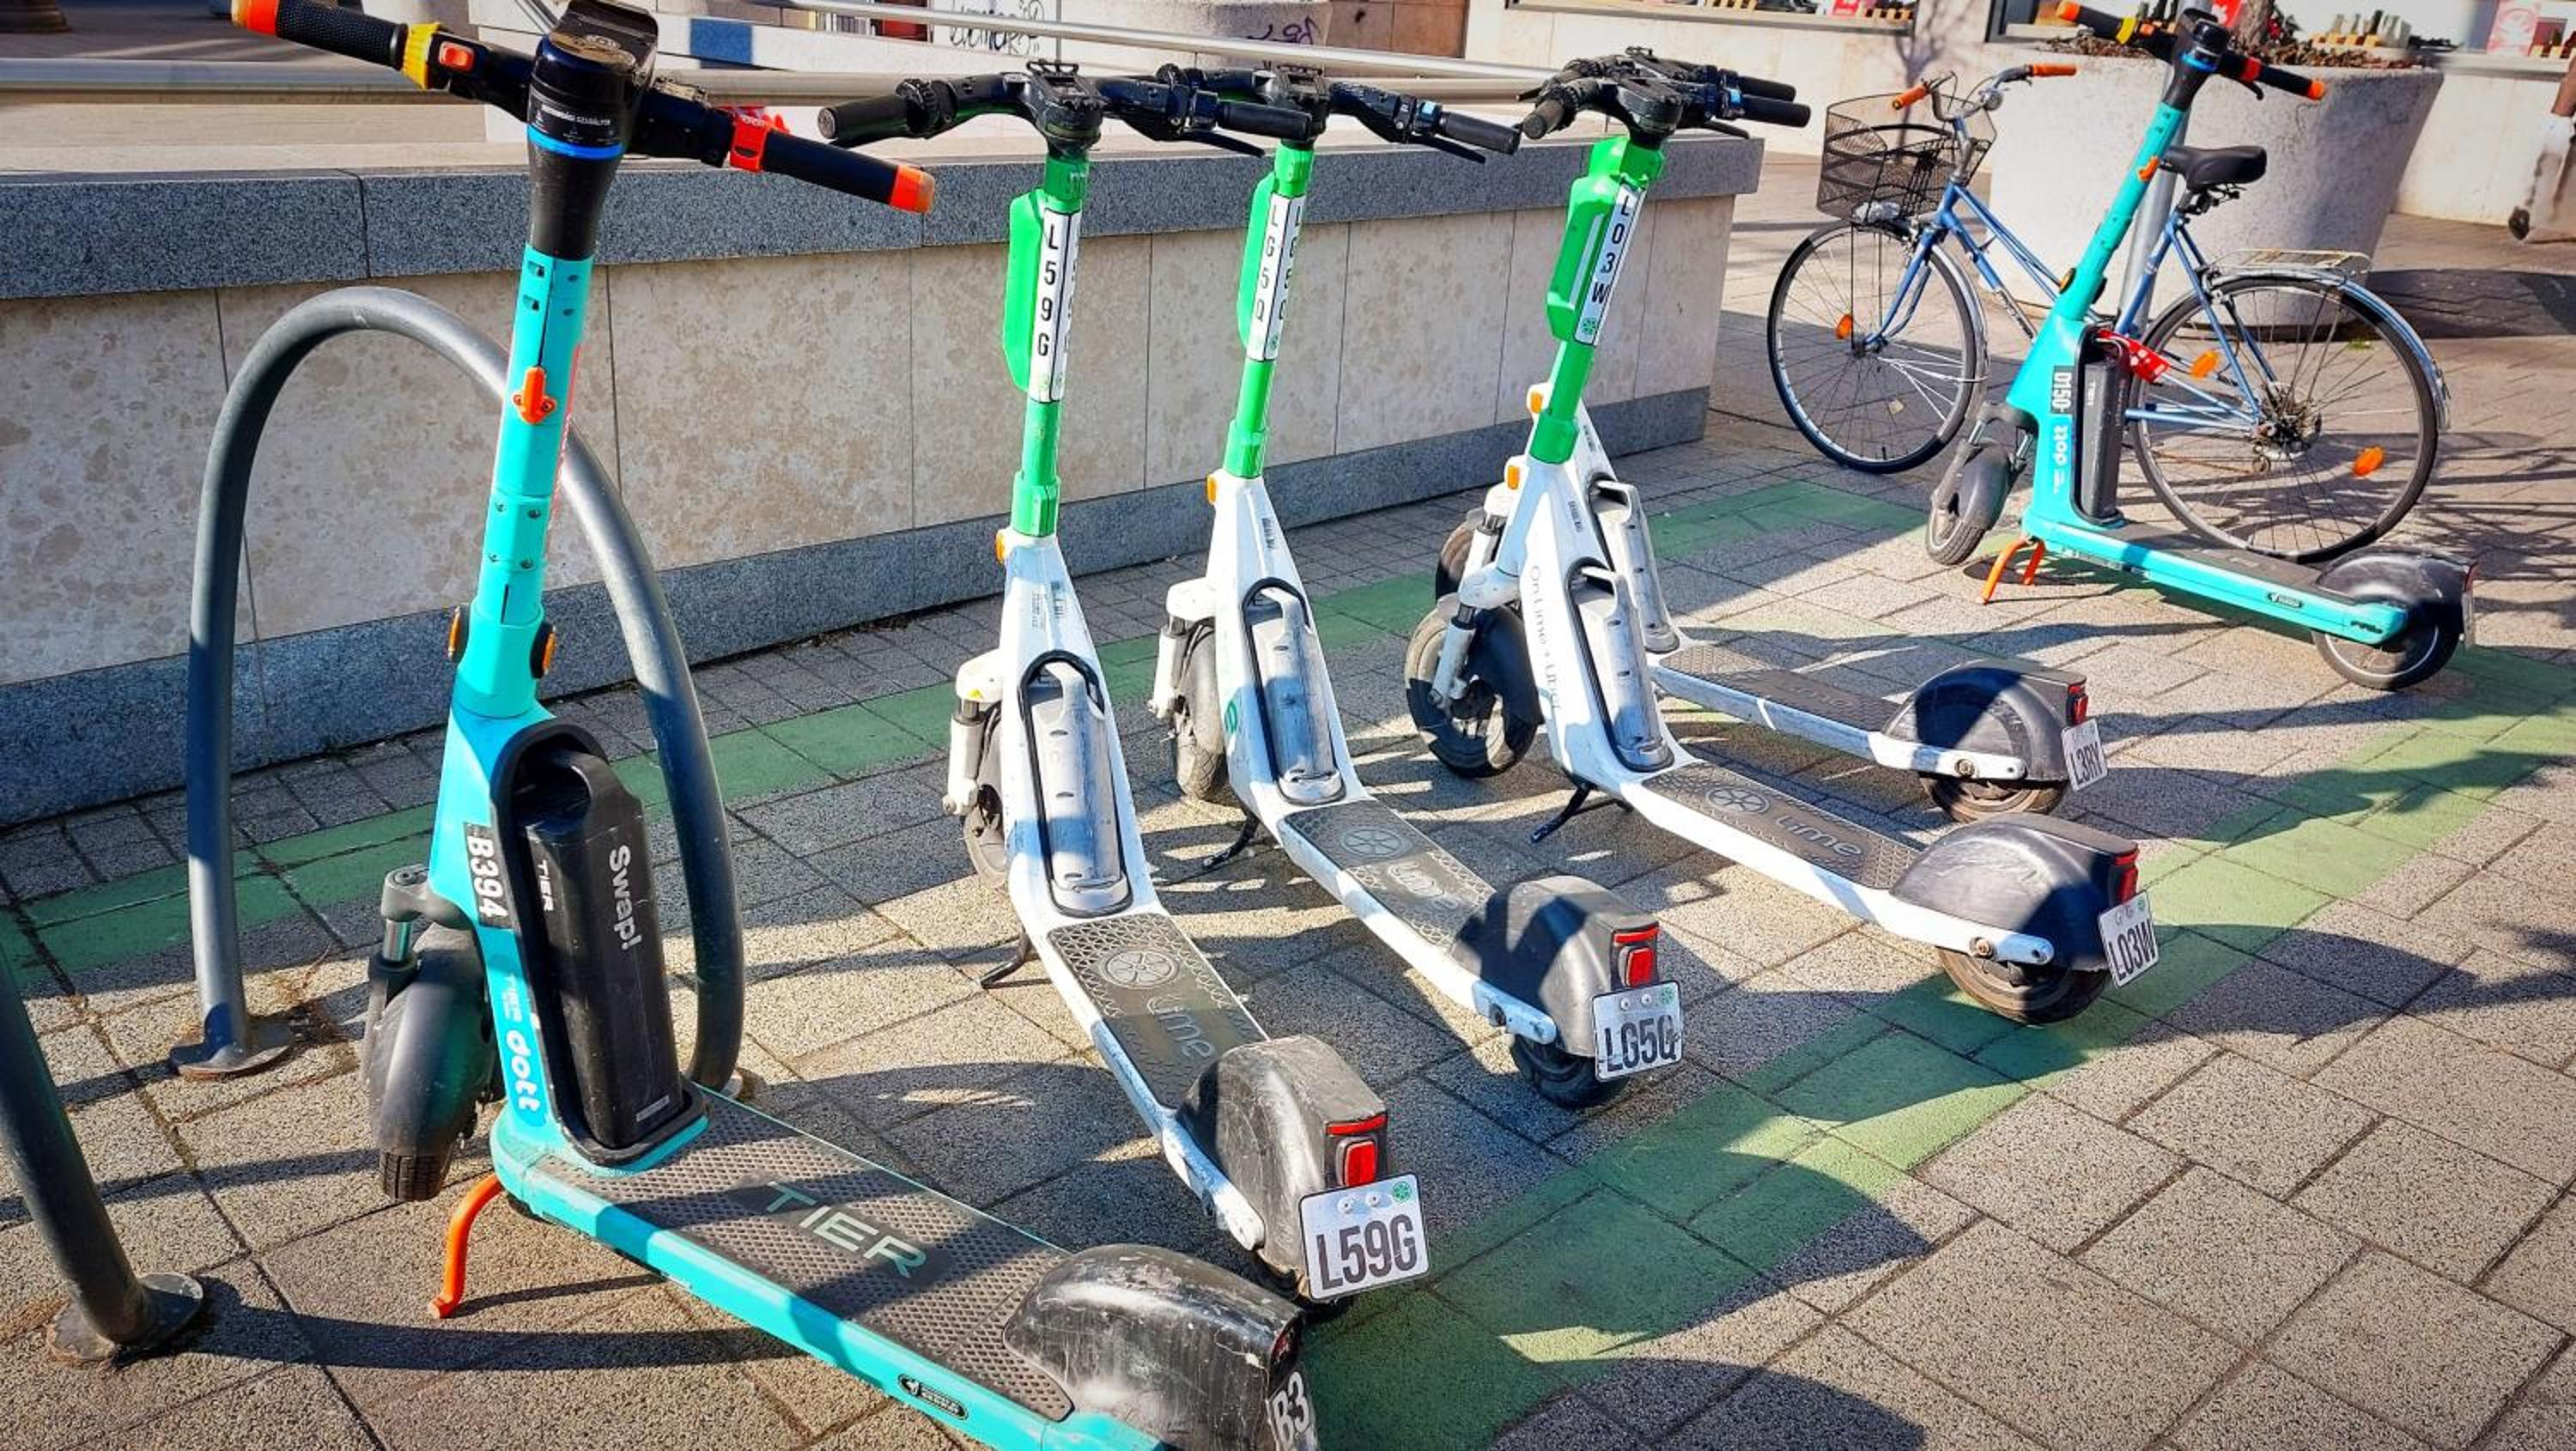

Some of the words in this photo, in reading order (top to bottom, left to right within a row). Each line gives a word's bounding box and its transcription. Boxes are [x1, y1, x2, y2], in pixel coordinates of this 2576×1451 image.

[1037, 224, 1060, 357] L59G
[1256, 206, 1279, 323] LG5Q
[2053, 426, 2068, 466] dott
[1776, 815, 1863, 857] Lime
[467, 835, 508, 919] B394
[538, 859, 555, 912] TIER
[609, 844, 642, 950] Swap!
[1146, 994, 1216, 1059] Lime
[1604, 1014, 1678, 1072] LG5Q
[506, 1029, 540, 1113] dott
[767, 1181, 927, 1278] TIER
[1316, 1213, 1417, 1290] L59G
